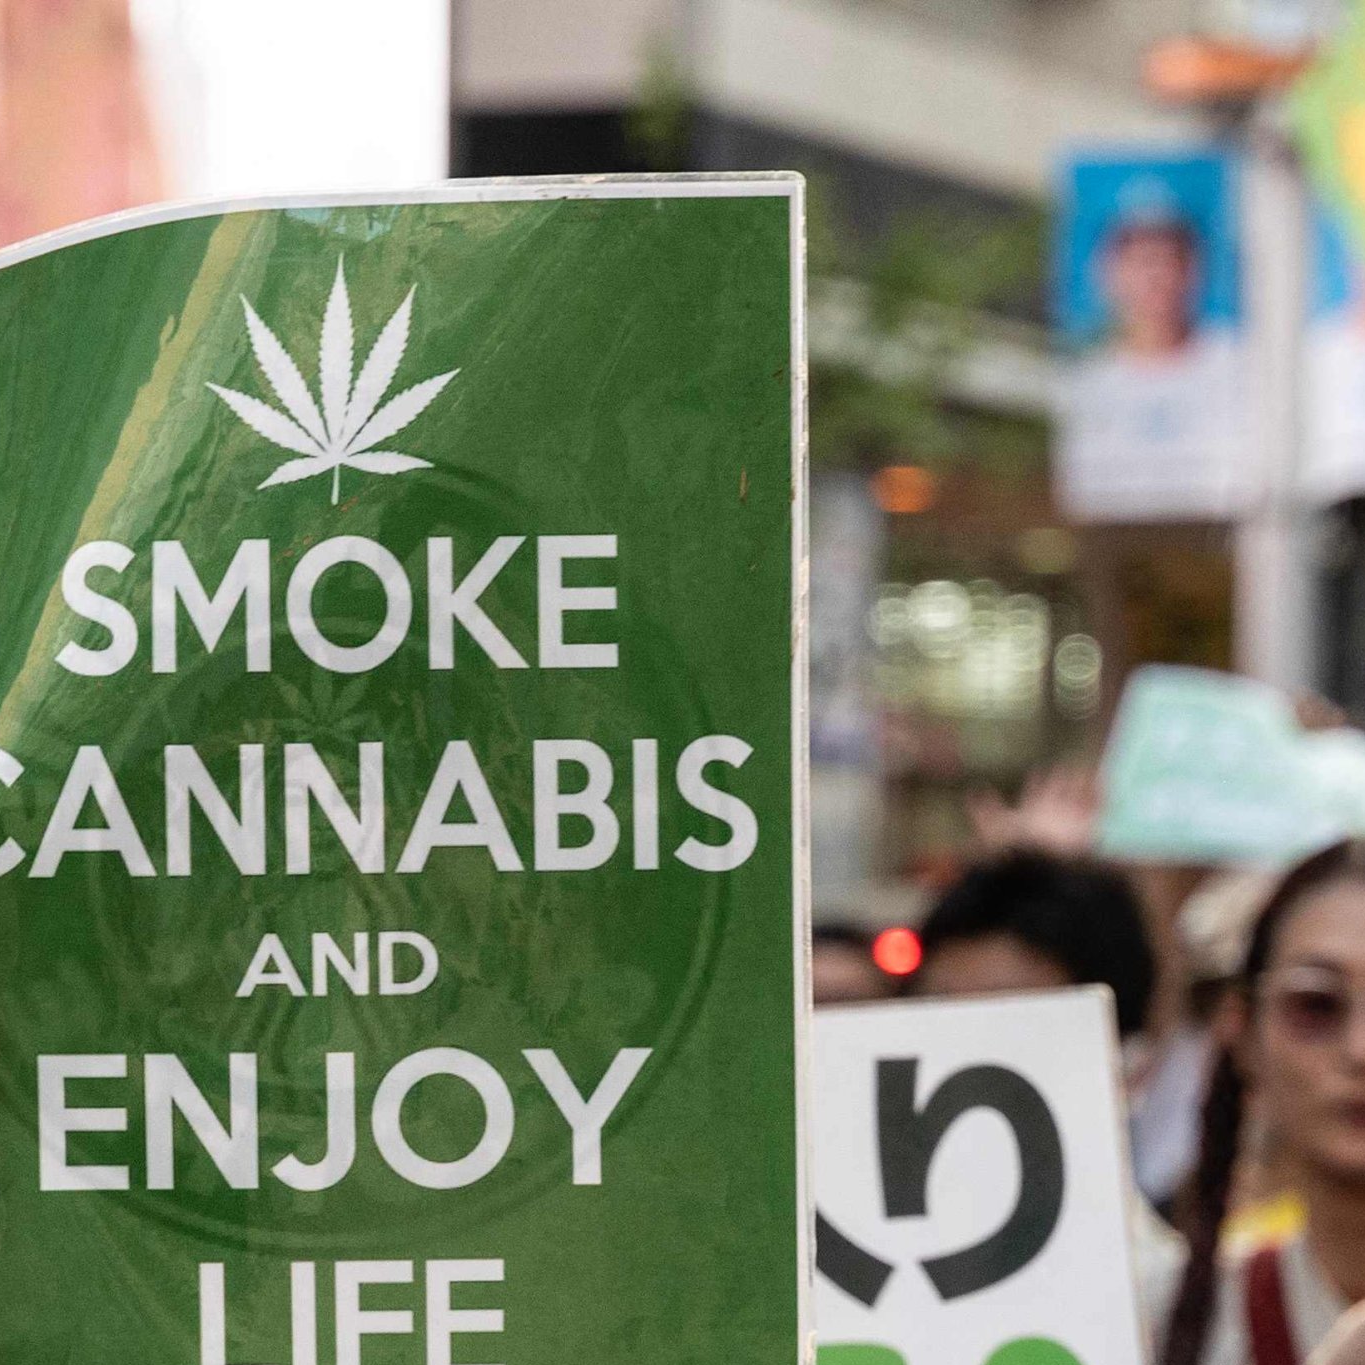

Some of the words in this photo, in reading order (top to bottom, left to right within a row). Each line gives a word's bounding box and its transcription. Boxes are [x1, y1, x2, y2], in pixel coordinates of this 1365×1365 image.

[52, 535, 619, 676] SMOKE
[235, 931, 439, 998] AND
[37, 1046, 653, 1192] ENJOY
[815, 1057, 1066, 1309] り
